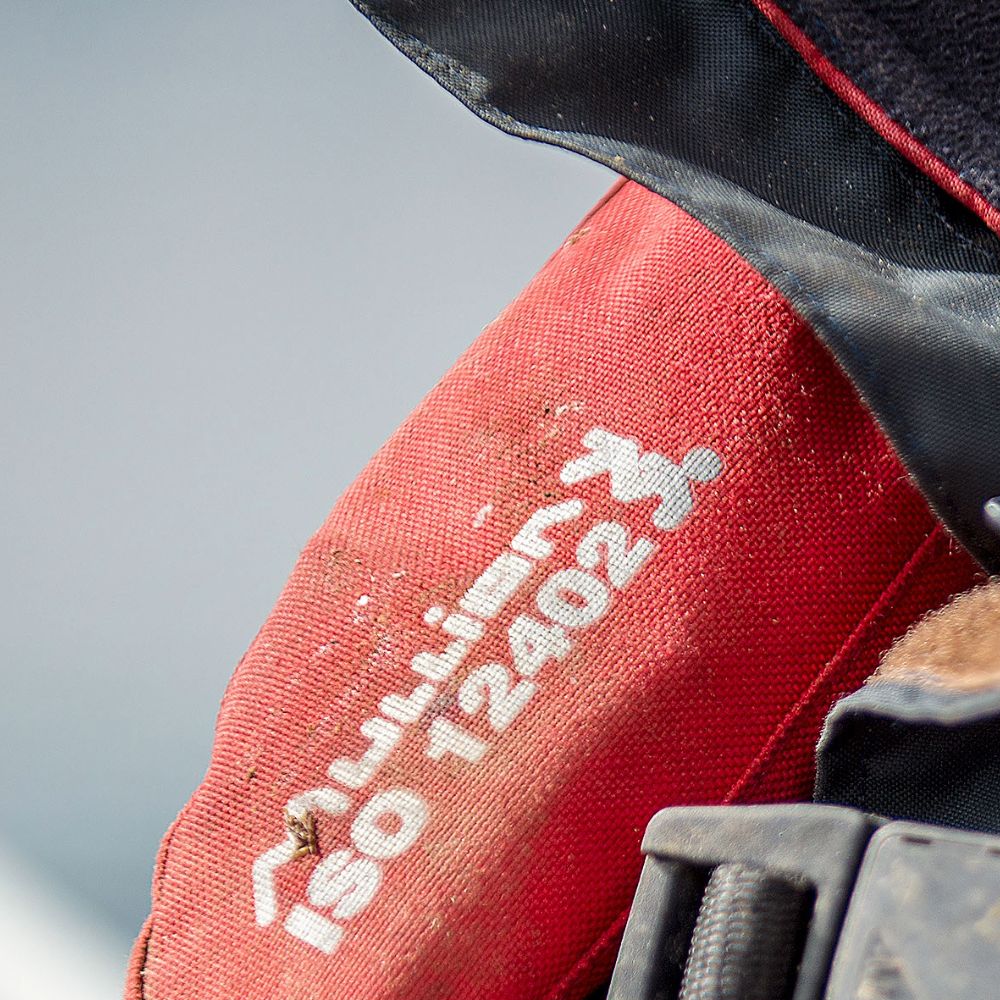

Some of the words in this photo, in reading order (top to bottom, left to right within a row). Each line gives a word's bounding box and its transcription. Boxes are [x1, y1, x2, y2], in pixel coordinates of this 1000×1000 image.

[252, 498, 585, 928] Mullion
[283, 787, 430, 955] ISO
[426, 520, 660, 764] 12402
